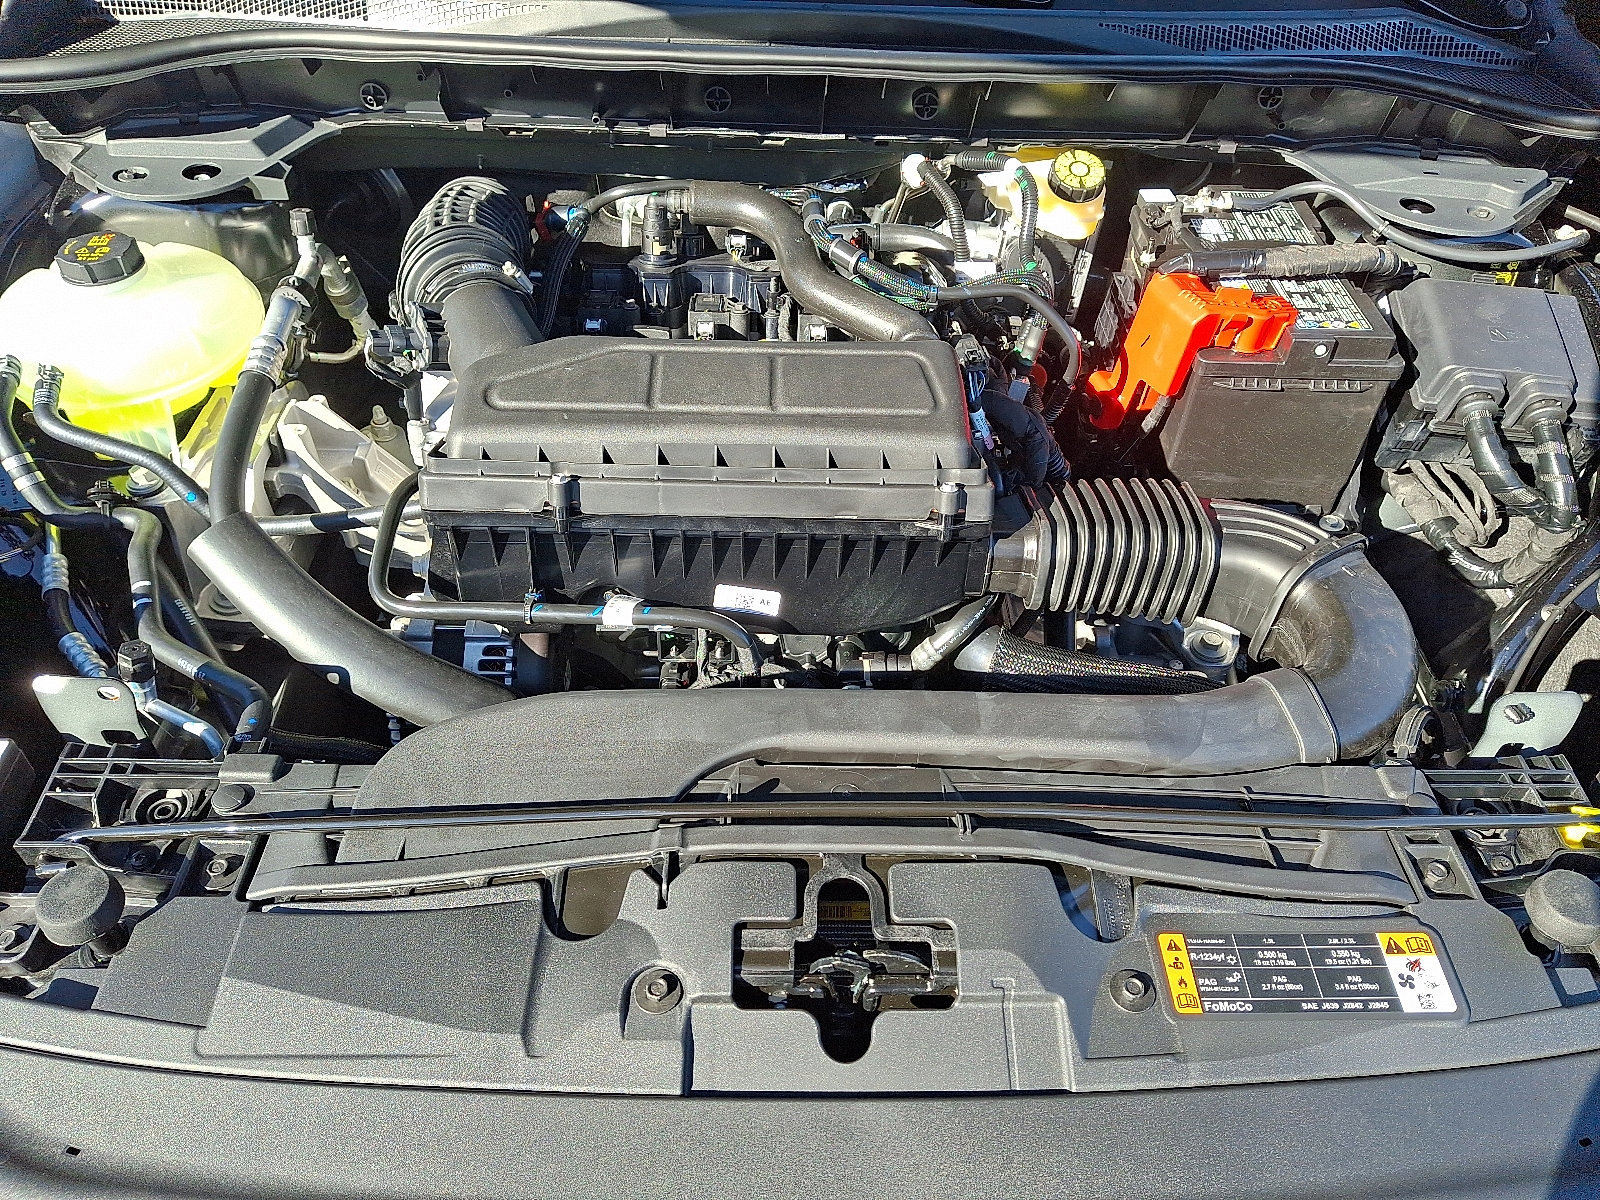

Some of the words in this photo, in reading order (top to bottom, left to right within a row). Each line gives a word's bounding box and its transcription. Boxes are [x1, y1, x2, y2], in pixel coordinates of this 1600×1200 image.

[1190, 952, 1226, 963] R-1234yf
[1277, 950, 1288, 960] kg
[1350, 950, 1361, 959] kg
[1198, 978, 1218, 986] PAG
[1272, 975, 1288, 983] PAG
[1346, 975, 1363, 983] PAG
[1204, 1001, 1254, 1012] FoMoCo
[1301, 1002, 1319, 1010] SAE
